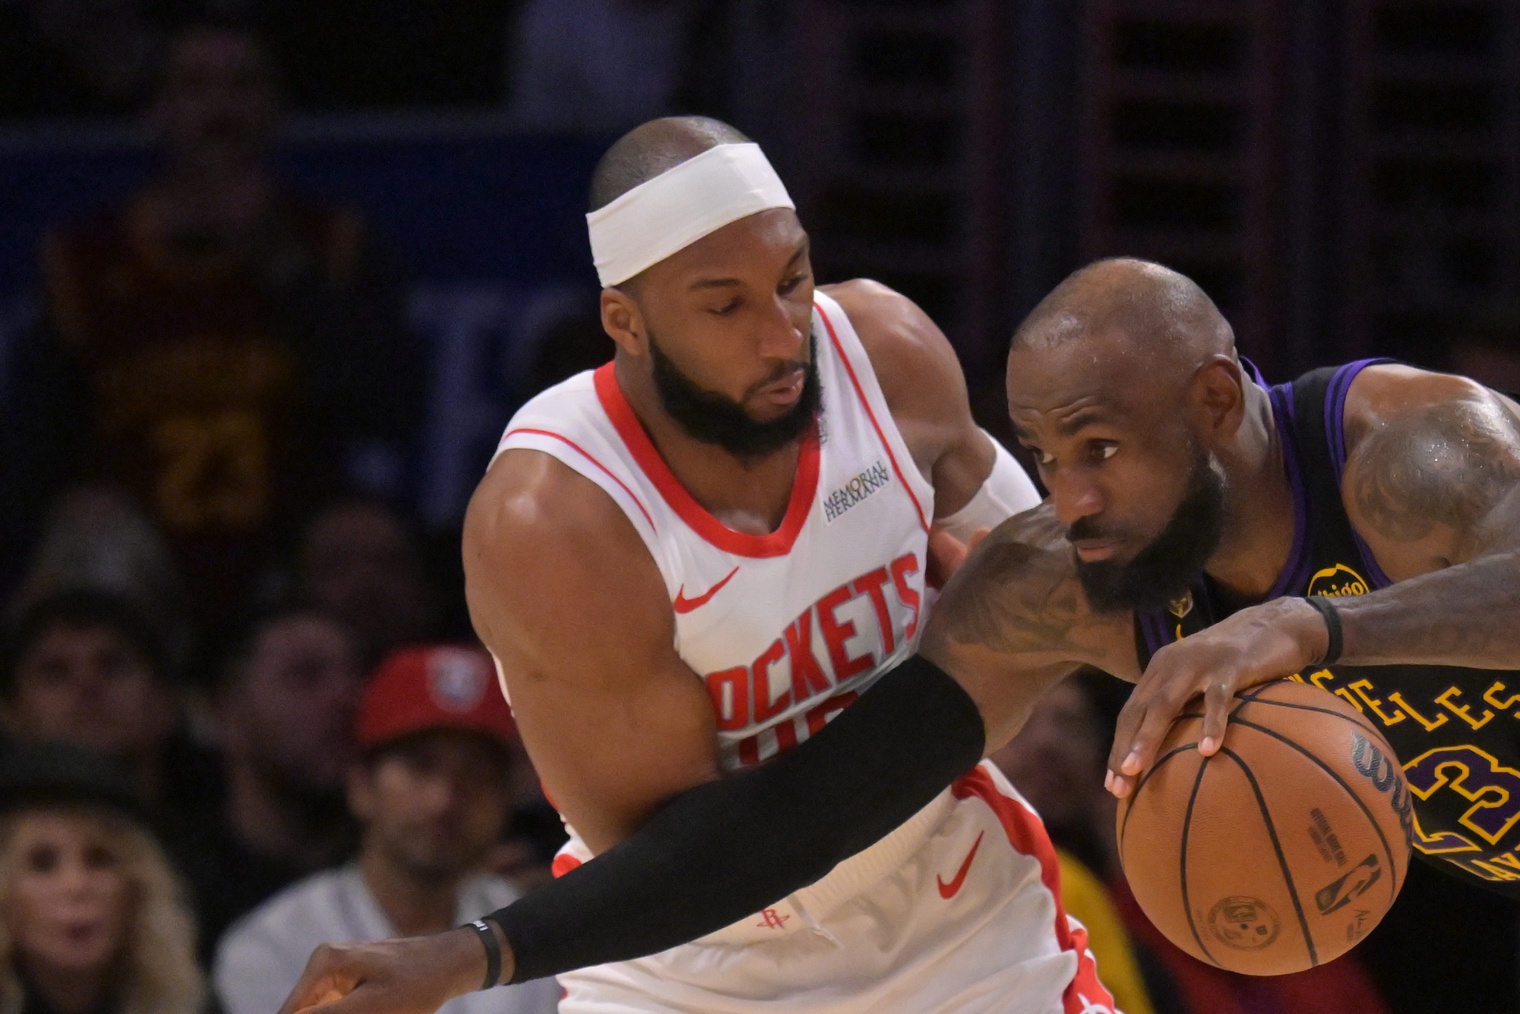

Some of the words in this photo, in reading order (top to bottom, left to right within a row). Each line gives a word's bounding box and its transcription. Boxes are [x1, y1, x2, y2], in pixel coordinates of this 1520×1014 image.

[823, 461, 887, 510] MEMORIAL
[825, 470, 889, 522] HERMANN
[706, 552, 921, 731] OCKETS
